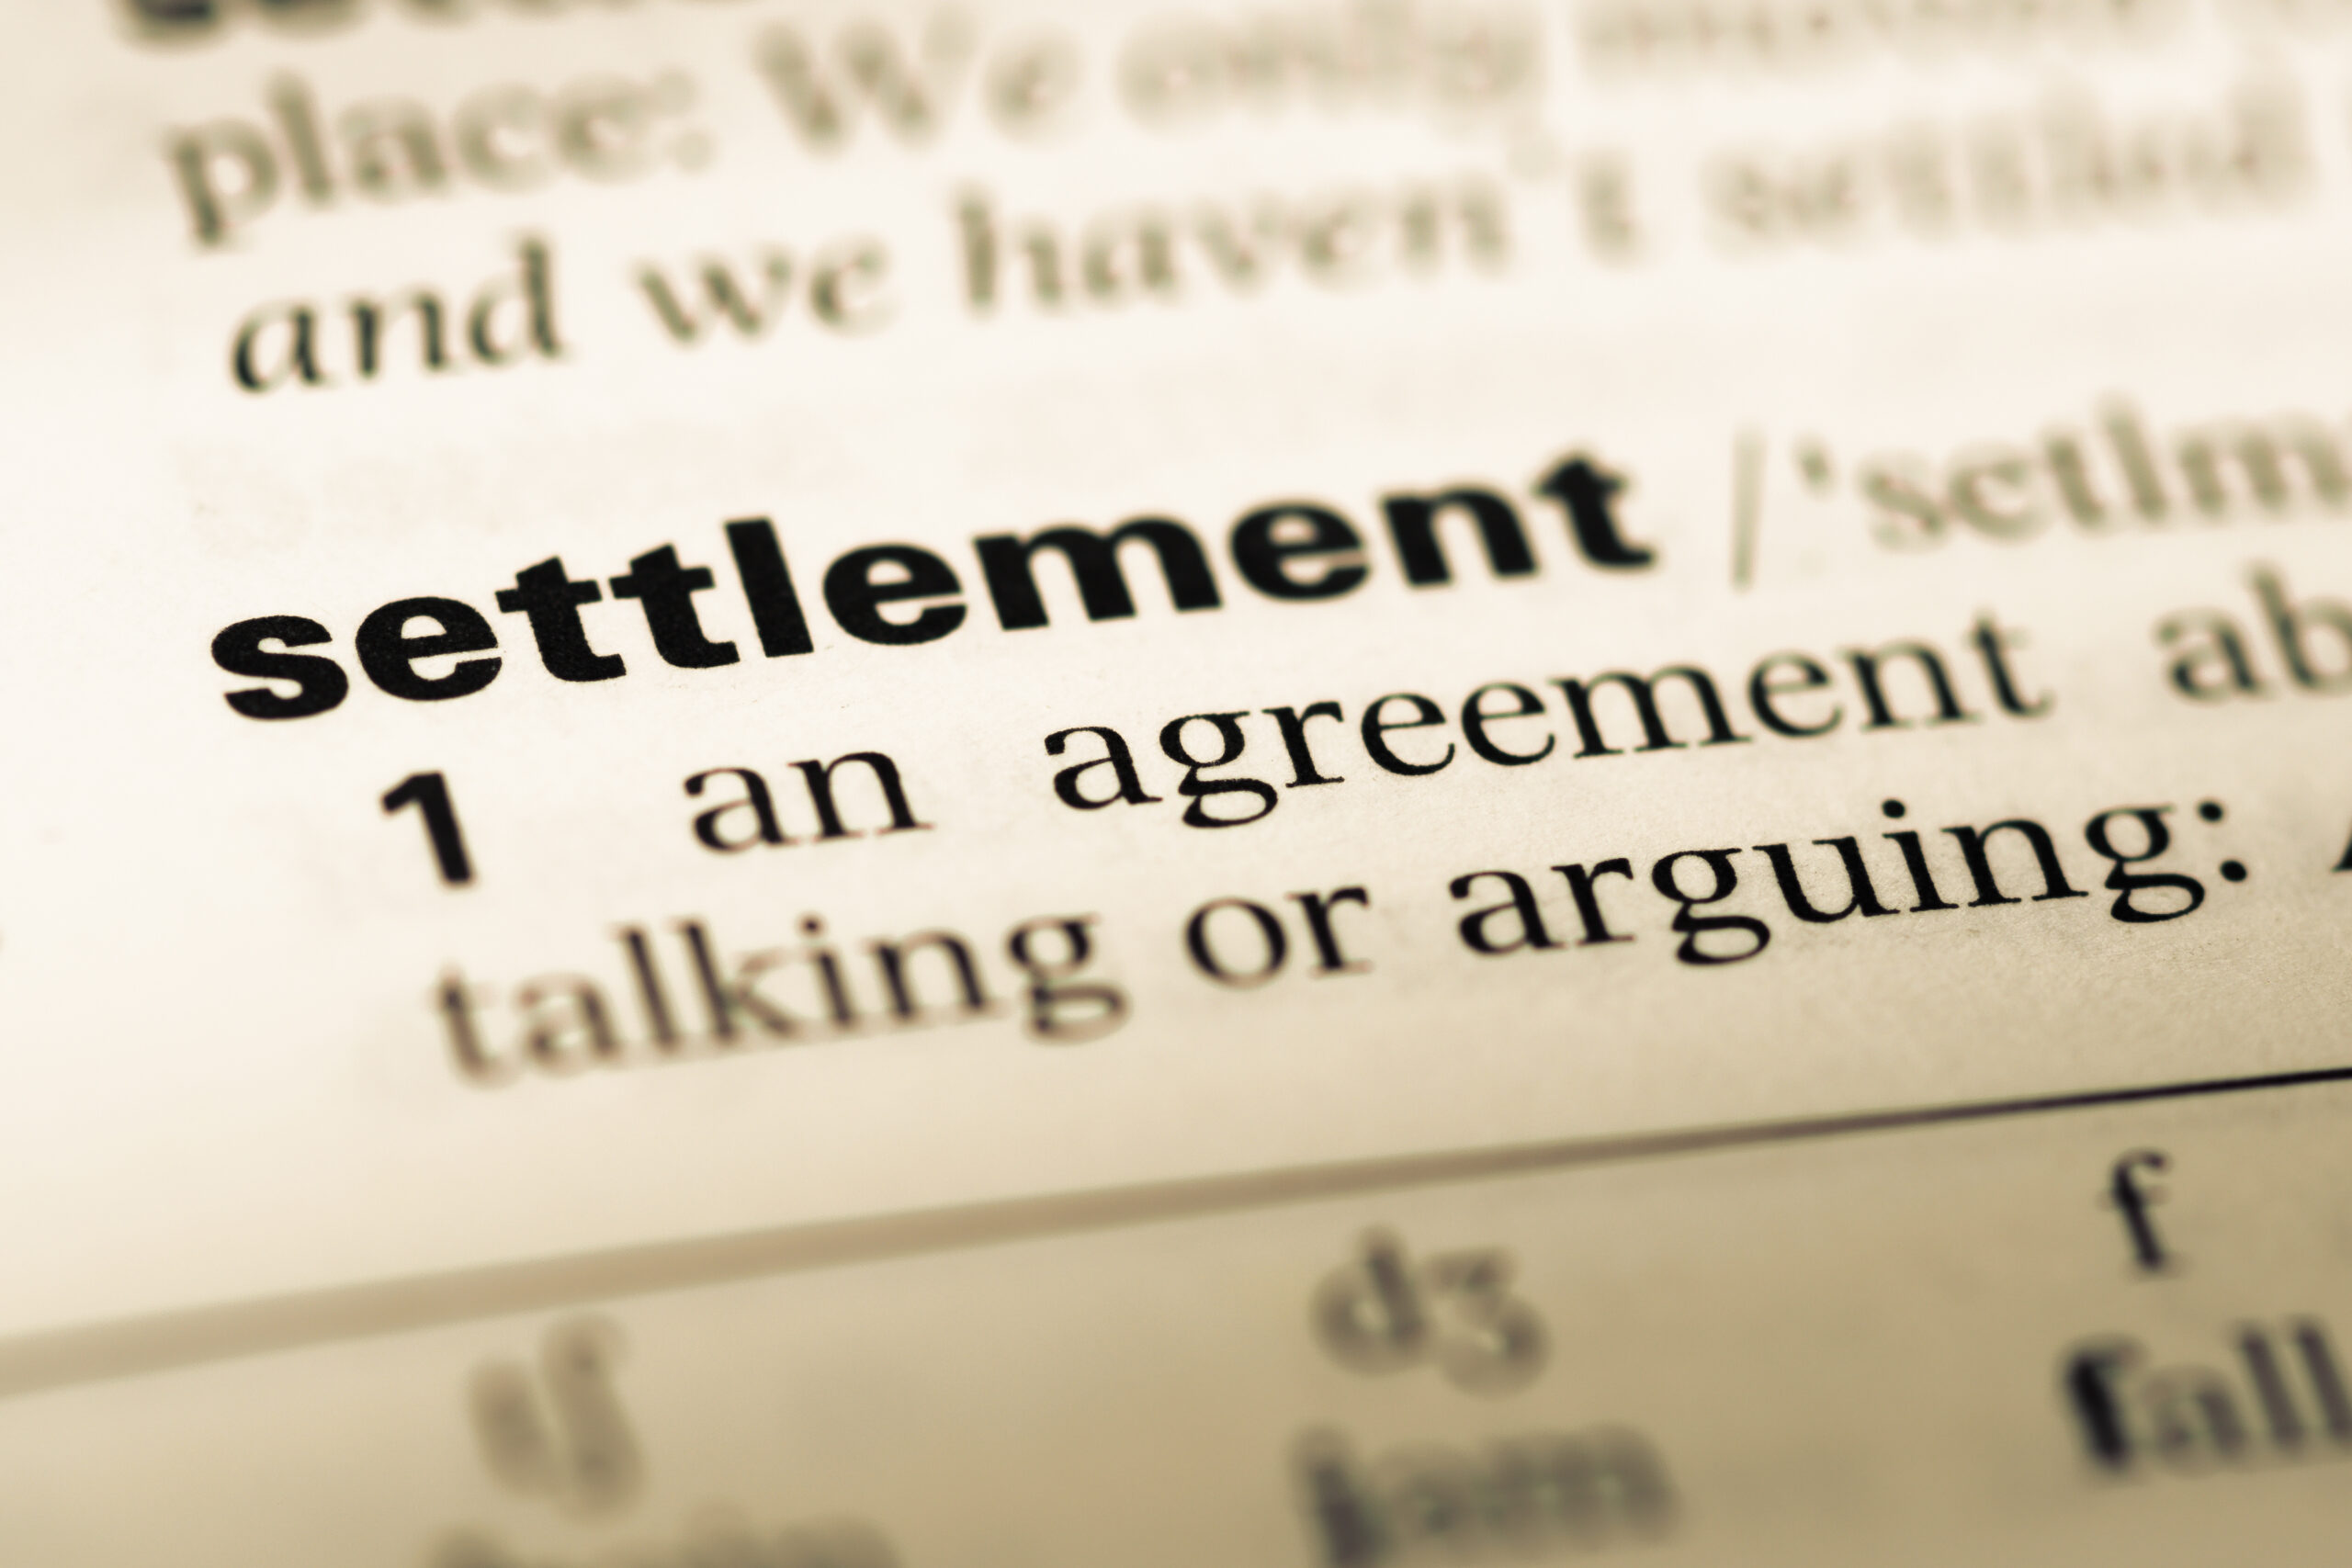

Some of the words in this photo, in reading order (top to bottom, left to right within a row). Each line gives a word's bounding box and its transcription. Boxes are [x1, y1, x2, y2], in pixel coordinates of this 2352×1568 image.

[167, 66, 715, 252] place:
[752, 18, 1086, 158] We
[230, 228, 574, 393] and
[634, 241, 897, 345] we
[209, 450, 1658, 722] settlement
[379, 770, 480, 888] 1
[683, 749, 935, 854] an
[1044, 608, 2052, 829] agreement
[2154, 560, 2352, 703] ab
[427, 912, 1130, 1087] talking
[1183, 885, 1372, 989] or
[1449, 797, 2249, 966] arguing:
[2099, 1146, 2179, 1275] f
[2058, 1315, 2352, 1479] fall
